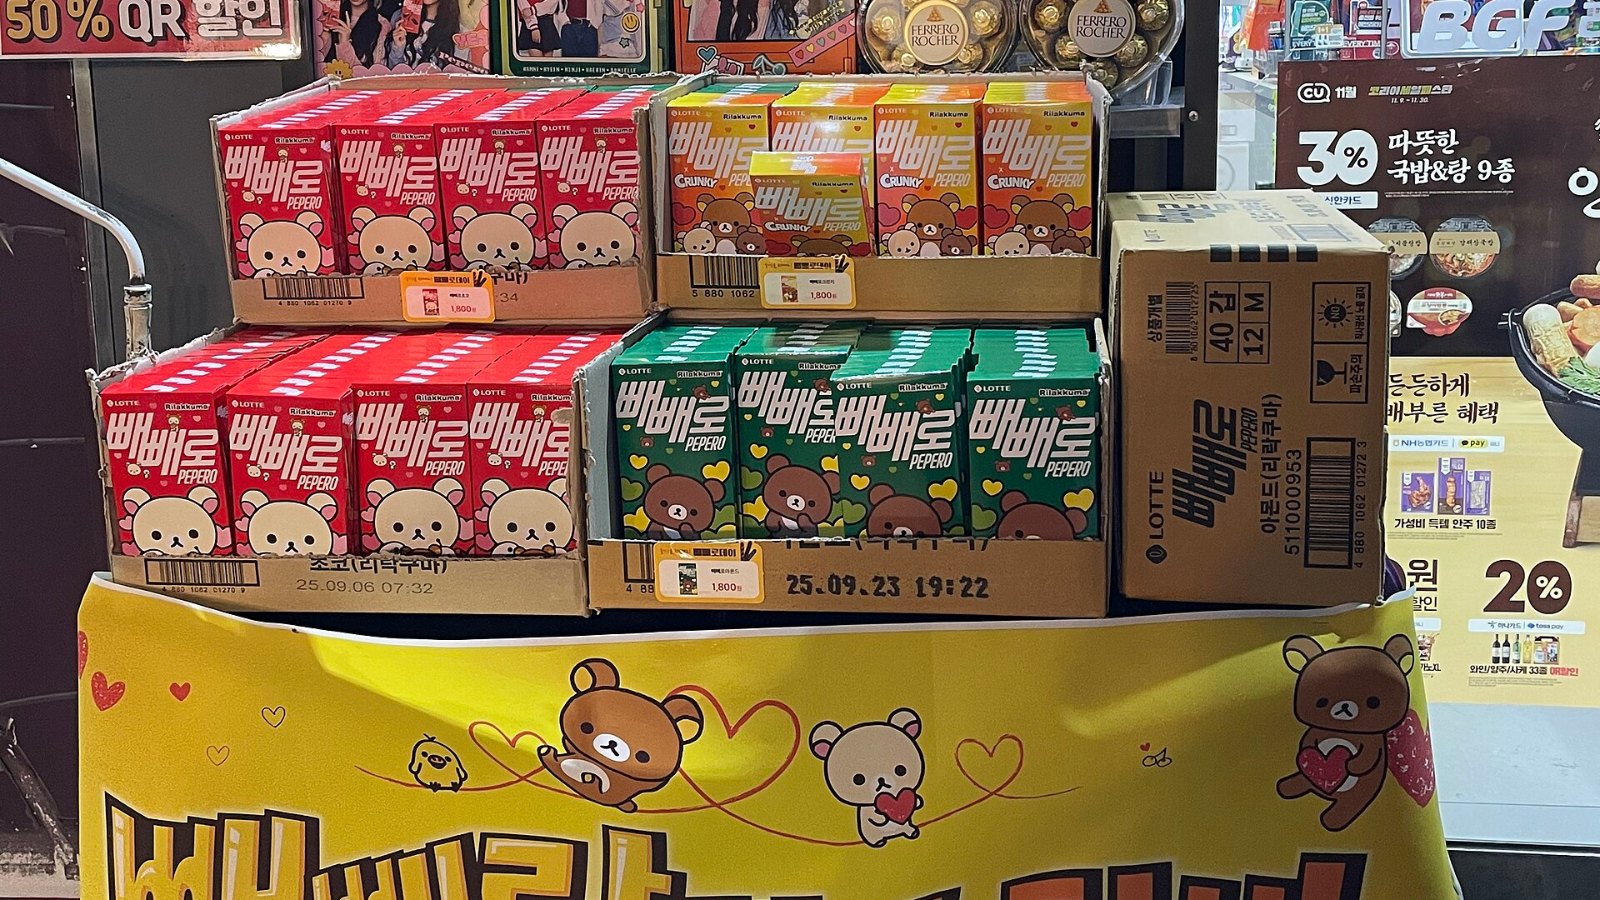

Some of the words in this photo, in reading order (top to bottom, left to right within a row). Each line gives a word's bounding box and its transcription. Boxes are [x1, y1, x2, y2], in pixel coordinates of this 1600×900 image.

[6, 0, 58, 39] 50
[66, 0, 110, 38] %
[119, 0, 185, 42] QR
[197, 0, 283, 36] 할인
[911, 23, 960, 36] FERRERO
[1077, 15, 1127, 28] FERRERO
[911, 34, 960, 46] ROCHER
[1076, 26, 1126, 39] ROCHER
[1335, 86, 1357, 99] 11월
[876, 119, 973, 178] 빼빼로
[983, 119, 1090, 179] 빼빼로
[1388, 129, 1459, 155] 따뜻한
[439, 138, 539, 194] 빼빼로
[540, 136, 640, 193] 빼빼로
[1297, 129, 1378, 186] 30%
[225, 145, 323, 203] 빼빼로
[340, 140, 437, 197] 빼빼로
[1387, 157, 1471, 185] 국밥&탕
[1477, 157, 1516, 184] 9종
[674, 173, 718, 188] CRUNKY
[728, 173, 751, 187] PEPE
[880, 174, 924, 189] CRUNKY
[933, 173, 970, 187] PEPERO
[987, 174, 1034, 190] CRUNKY
[1046, 173, 1087, 188] PEPERO
[286, 196, 323, 210] PEPERO
[399, 192, 436, 205] PEPERO
[501, 187, 537, 202] PEPERO
[755, 187, 862, 226] 빼빼로
[764, 221, 812, 232] CRUNKY
[823, 222, 861, 231] PEPERO
[692, 290, 698, 298] 5
[705, 290, 724, 298] 880
[731, 290, 755, 298] 1062
[1209, 290, 1236, 311] 갑
[1243, 293, 1265, 312] M
[1147, 294, 1163, 344] 상품개별
[1331, 306, 1340, 319] NO
[1209, 322, 1235, 353] 40
[1243, 327, 1264, 356] 12
[677, 370, 723, 378] Rilakkuma
[1349, 353, 1363, 394] 파손주의
[898, 383, 948, 392] Rilakkuma
[1039, 389, 1091, 397] Rilakkuma
[1388, 372, 1470, 398] 든든하게
[165, 403, 210, 411] Rilakkuma
[616, 380, 730, 443] 빼빼로
[738, 371, 835, 434] 빼빼로
[288, 408, 336, 416] Rilakkuma
[1387, 401, 1449, 424] 배부른
[1456, 401, 1499, 424] 혜택
[356, 403, 470, 467] 빼빼로
[835, 395, 956, 461] 빼빼로
[968, 399, 1096, 468] 빼빼로
[1240, 407, 1258, 453] PEPERO
[107, 412, 219, 476] 빼빼로
[229, 413, 343, 481] 빼빼로
[684, 435, 727, 451] PEPERO
[1357, 440, 1367, 448] 3
[1470, 439, 1485, 447] pay
[423, 460, 466, 476] PEPERO
[538, 460, 568, 476] PEPE
[908, 452, 953, 470] PEPERO
[1044, 460, 1092, 478] PEPERO
[1172, 399, 1247, 529] 빼빼로
[1260, 393, 1283, 534] 아몬드(리락쿠마)
[177, 469, 218, 484] PEPERO
[1356, 454, 1367, 488] 01272
[296, 475, 339, 491] PEPERO
[1149, 471, 1164, 540] LOTTE
[1285, 450, 1302, 555] 511000953
[1355, 494, 1366, 523] 1062
[1394, 518, 1426, 529] 가성비
[1428, 518, 1450, 529] 득템
[1452, 519, 1474, 529] 안주
[1476, 519, 1497, 530] 10종
[1355, 531, 1365, 554] 880
[1354, 561, 1363, 569] 4
[296, 578, 375, 593] 25.09.06
[381, 581, 433, 594] 07:32
[626, 584, 633, 592] 4
[640, 584, 655, 593] 88
[786, 573, 900, 597] 25.09.23
[915, 575, 989, 598] 19:22
[1483, 559, 1572, 614] 20%
[1528, 666, 1548, 675] 33종
